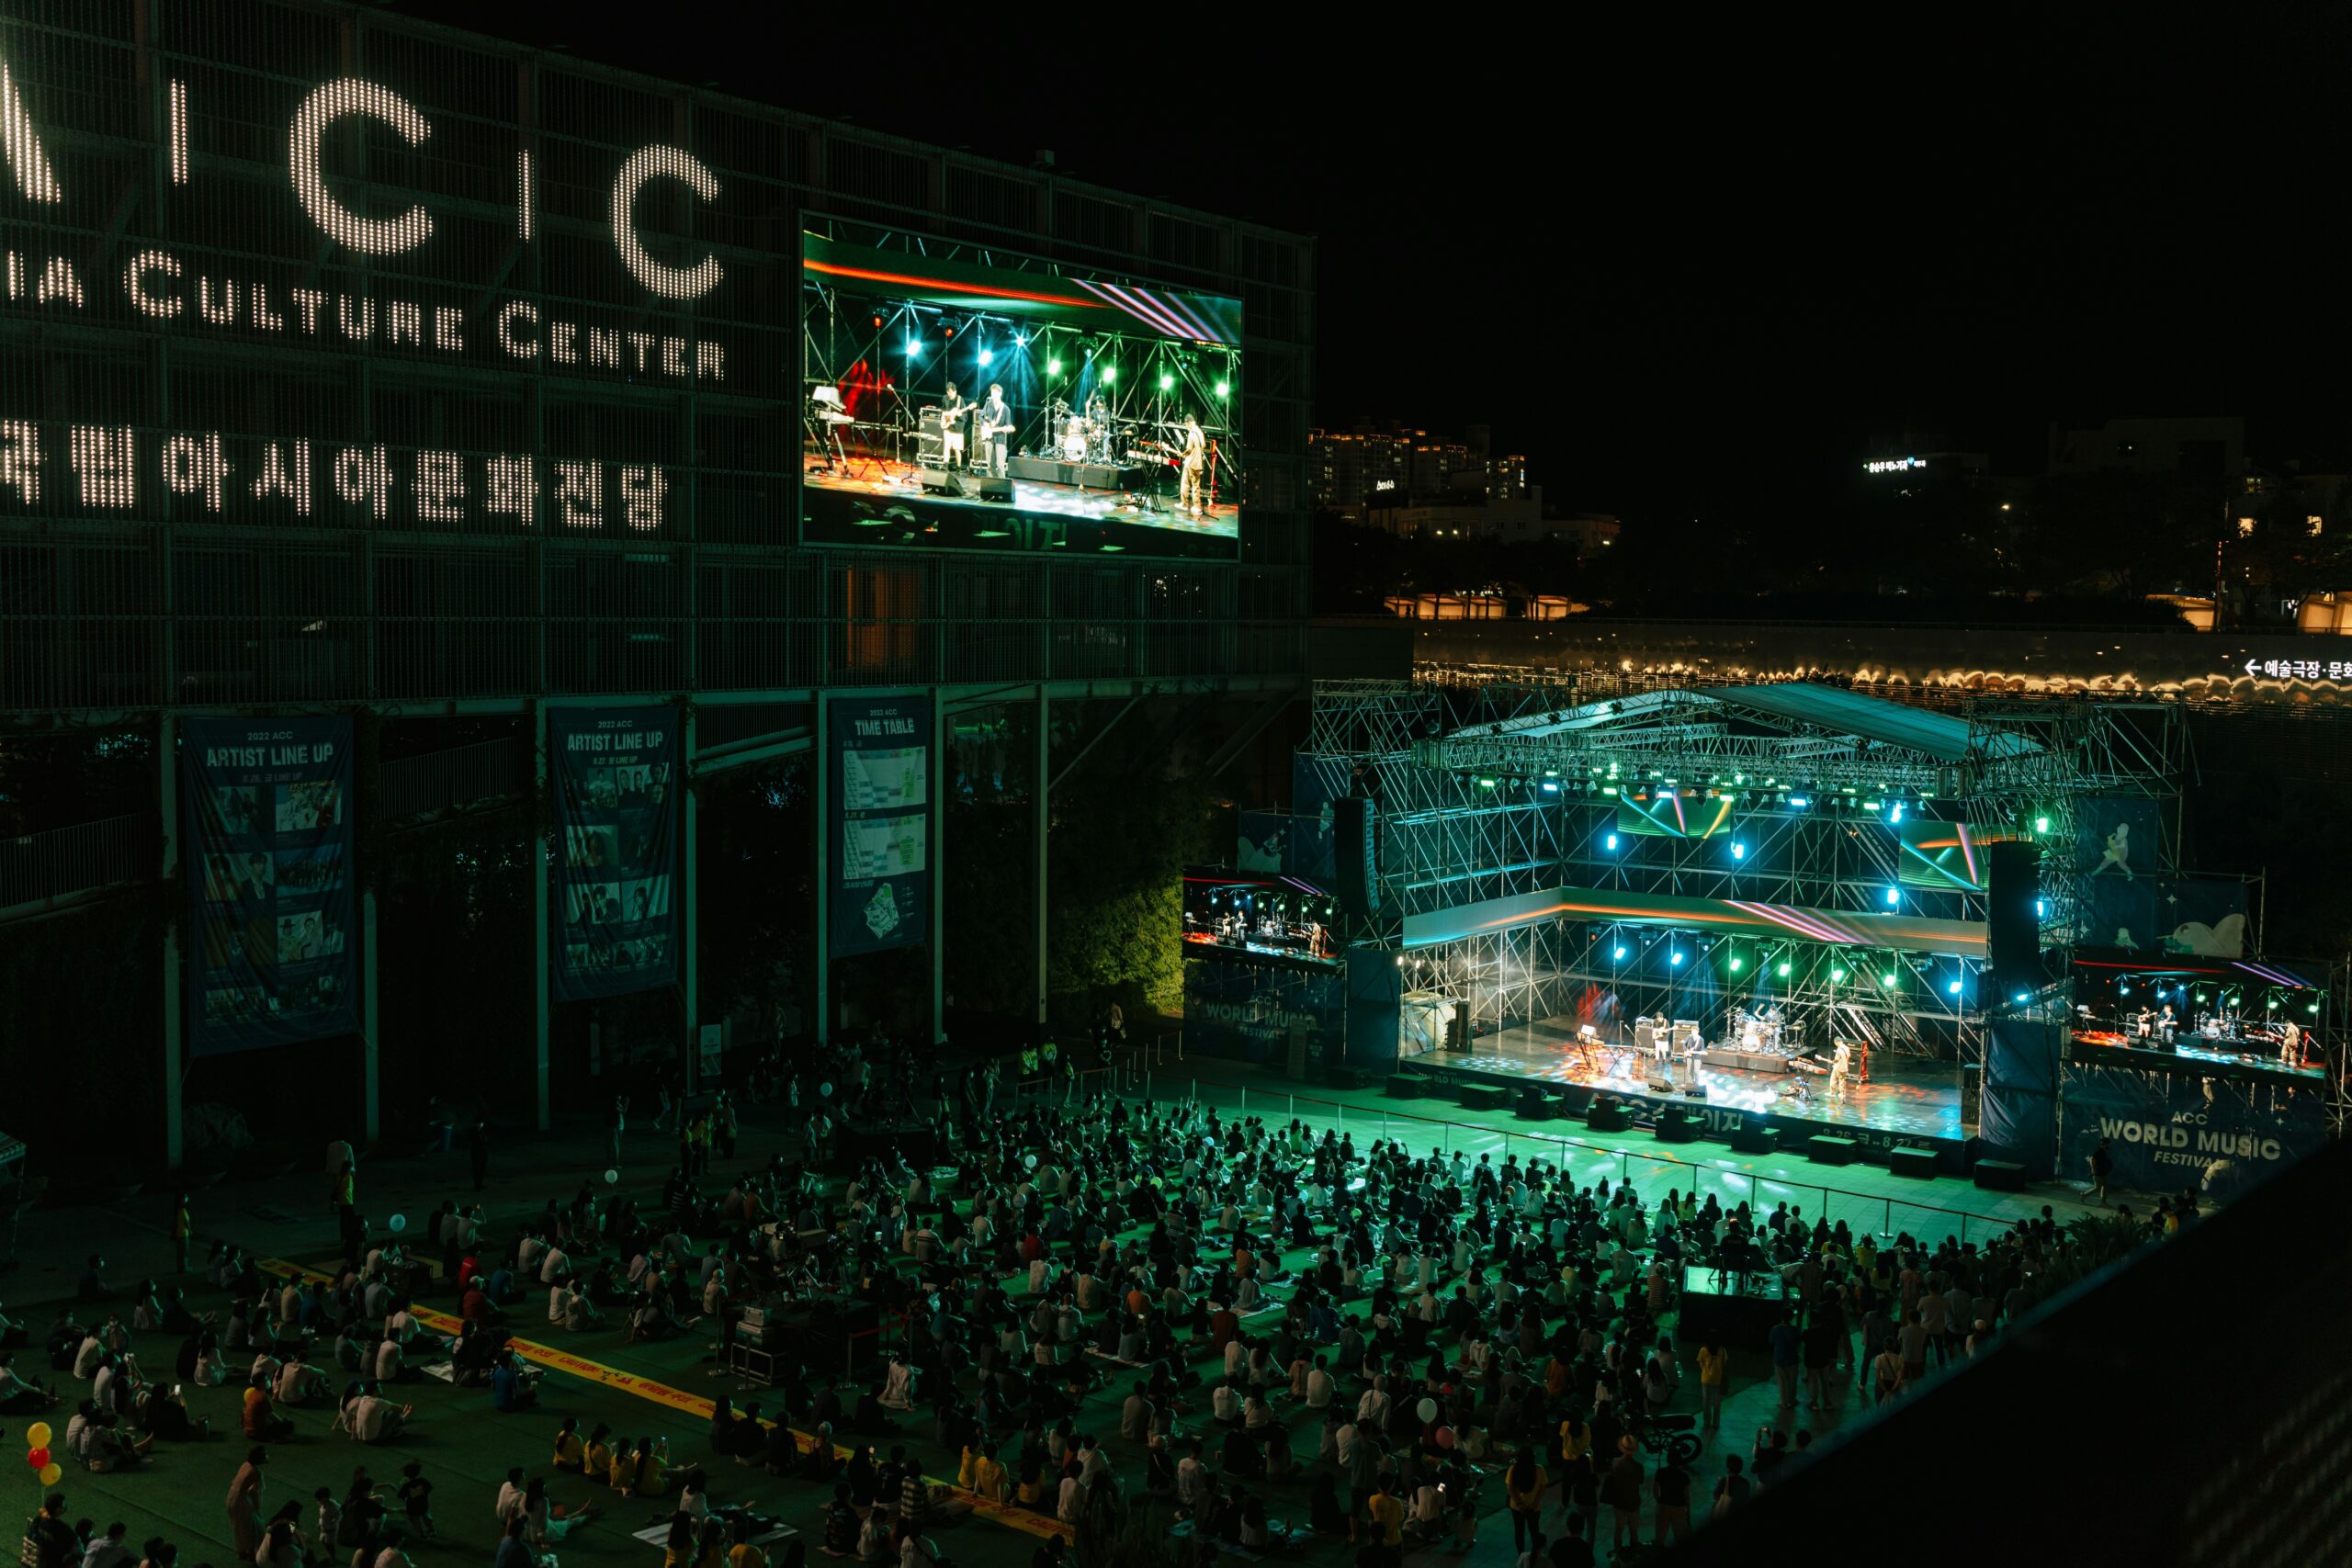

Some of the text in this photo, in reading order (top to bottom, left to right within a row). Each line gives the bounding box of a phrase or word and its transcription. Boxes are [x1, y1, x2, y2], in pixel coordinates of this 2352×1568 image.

[123, 249, 463, 351] CULTURE
[499, 299, 725, 380] CENTER
[598, 720, 616, 728] 2022
[854, 717, 915, 735] TIME TABLE
[247, 731, 294, 740] 2022 ACC
[568, 730, 663, 751] ARTIST LINE UP
[207, 741, 334, 767] ARTIST LINE UP
[2171, 1111, 2208, 1125] ACC
[2100, 1117, 2281, 1161] WORLD MUSIC
[2154, 1150, 2213, 1168] FESTIVA
